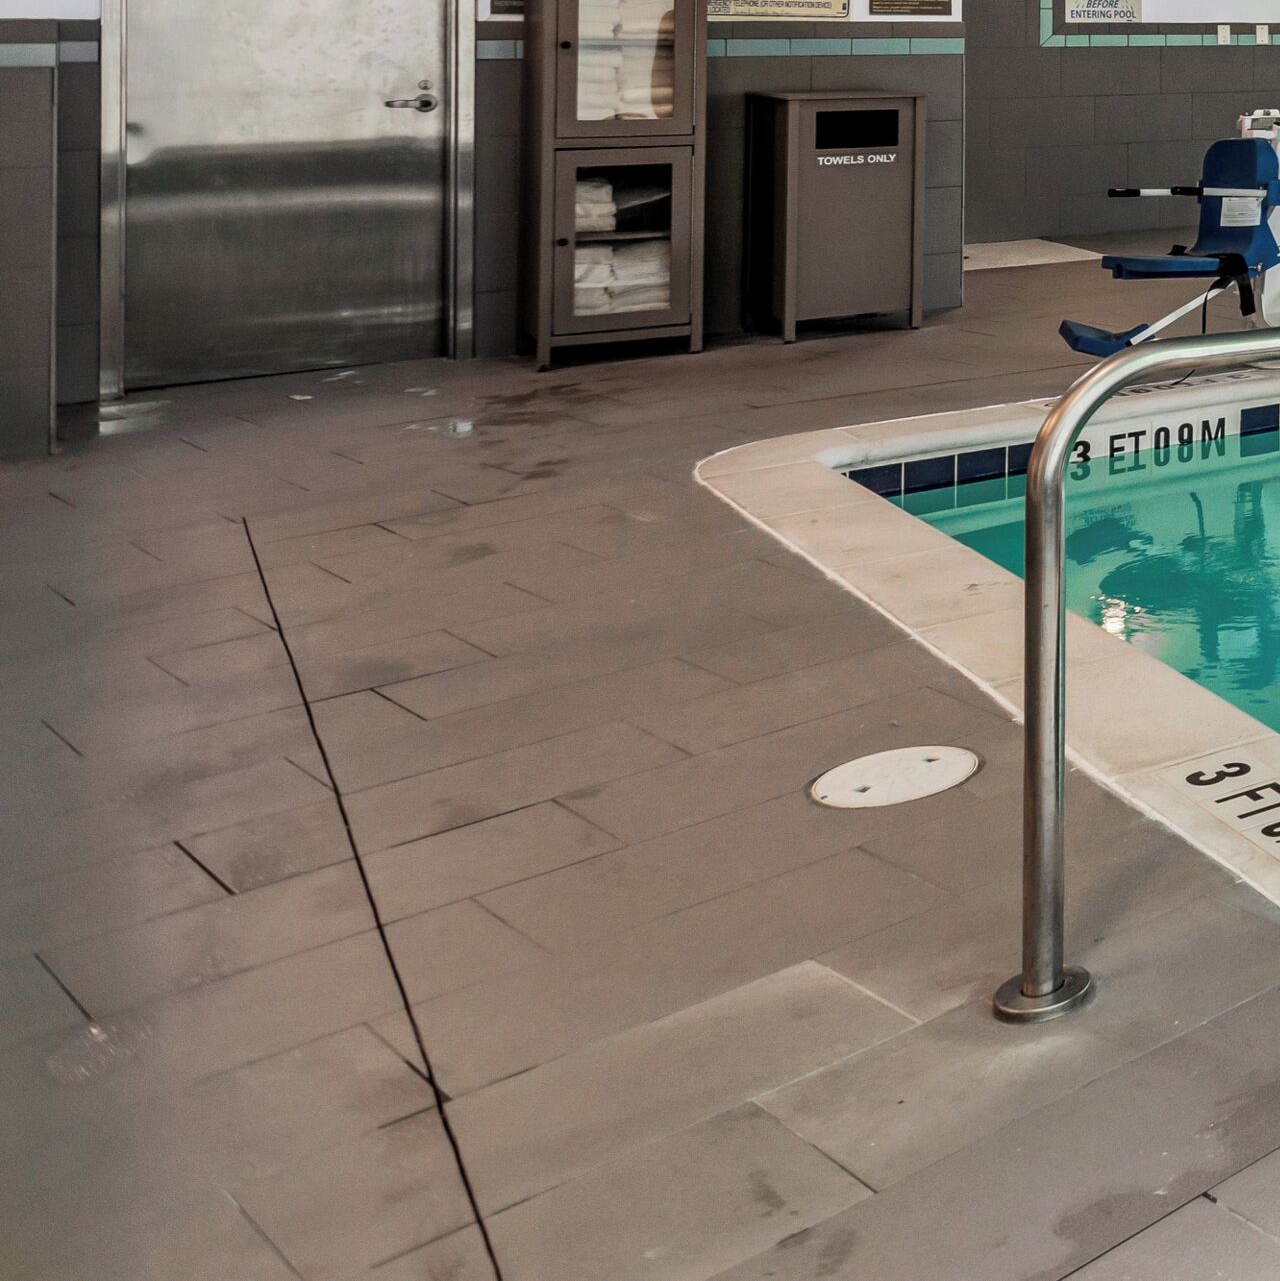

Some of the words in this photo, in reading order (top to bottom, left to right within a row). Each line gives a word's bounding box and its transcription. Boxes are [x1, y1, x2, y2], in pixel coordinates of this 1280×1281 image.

[1086, 0, 1119, 9] BEFORE
[1070, 10, 1112, 19] ENTERING
[1114, 10, 1136, 19] POOL
[817, 155, 864, 165] TOWELS
[867, 153, 896, 163] ONLY
[1186, 763, 1251, 786] 3
